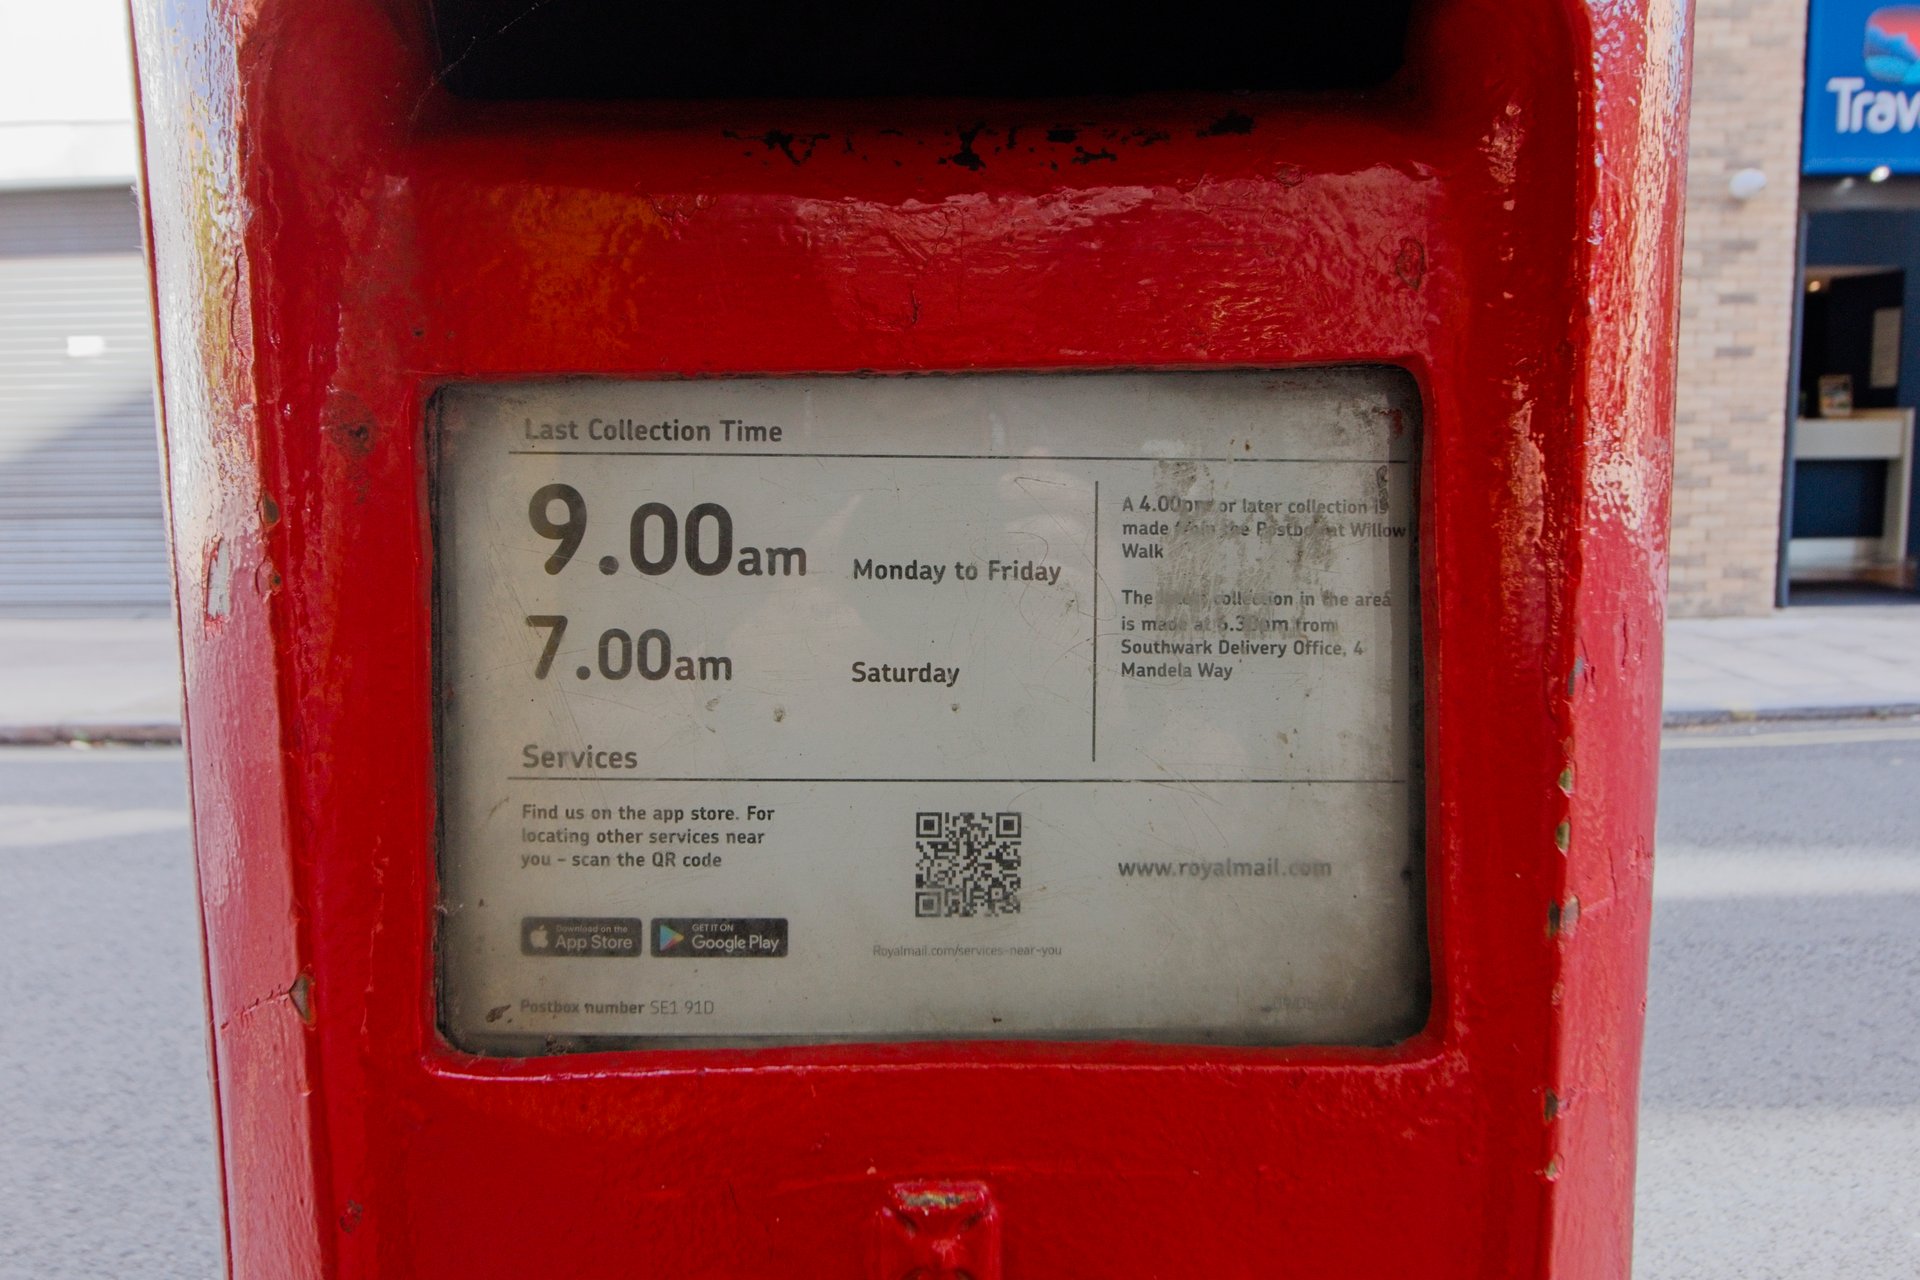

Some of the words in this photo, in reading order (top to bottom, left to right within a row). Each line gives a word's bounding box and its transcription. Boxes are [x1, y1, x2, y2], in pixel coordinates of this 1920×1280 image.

[1825, 76, 1920, 134] Trav
[524, 417, 579, 440] Last
[588, 418, 711, 441] Collection
[719, 419, 783, 442] Time
[1122, 496, 1134, 512] A
[1219, 500, 1236, 513] or
[1242, 498, 1282, 514] later
[1288, 499, 1368, 514] collection
[1375, 499, 1388, 514] is
[528, 482, 807, 576] 9.00am
[853, 558, 946, 585] Monday
[954, 561, 978, 580] to
[988, 559, 1062, 586] Friday
[1122, 520, 1169, 536] made
[1351, 522, 1407, 538] Willow
[1121, 543, 1164, 558] Walk
[1121, 589, 1153, 605] The
[1300, 591, 1315, 606] in
[1320, 590, 1348, 607] the
[1355, 594, 1391, 607] area
[1121, 616, 1135, 631] is
[1194, 617, 1212, 631] at
[1296, 617, 1338, 632] from
[525, 614, 733, 681] 7.00am
[851, 661, 960, 687] Saturday
[1121, 639, 1212, 654] Southwark
[1218, 640, 1287, 658] Delivery
[1293, 640, 1347, 657] Office,
[1353, 641, 1365, 655] 4
[1121, 662, 1192, 677] Mandela
[1198, 662, 1233, 681] Way
[522, 744, 638, 769] Services
[522, 804, 558, 819] Find
[565, 808, 584, 820] us
[591, 808, 612, 820] on
[618, 805, 646, 820] the
[653, 808, 684, 823] app
[691, 806, 740, 821] store.
[747, 805, 775, 821] For
[522, 827, 590, 846] locating
[596, 828, 643, 844] other
[649, 828, 719, 844] services
[726, 832, 765, 844] near
[521, 854, 551, 869] you
[572, 854, 610, 867] scan
[617, 852, 645, 867] the
[652, 851, 676, 868] QR
[683, 852, 722, 868] code
[1117, 857, 1333, 881] www.royalmail.com
[614, 925, 628, 933] the
[692, 923, 710, 932] GET
[711, 923, 718, 932] IT
[719, 923, 734, 932] ON
[555, 934, 588, 951] App
[591, 934, 633, 949] Store
[692, 934, 746, 953] Google
[749, 934, 780, 952] Play
[872, 944, 1062, 958] Royalmail.com/services-near-you
[520, 999, 580, 1013] Postbox
[584, 1000, 645, 1014] number
[650, 1000, 678, 1015] SE1
[684, 1000, 714, 1014] 91D
